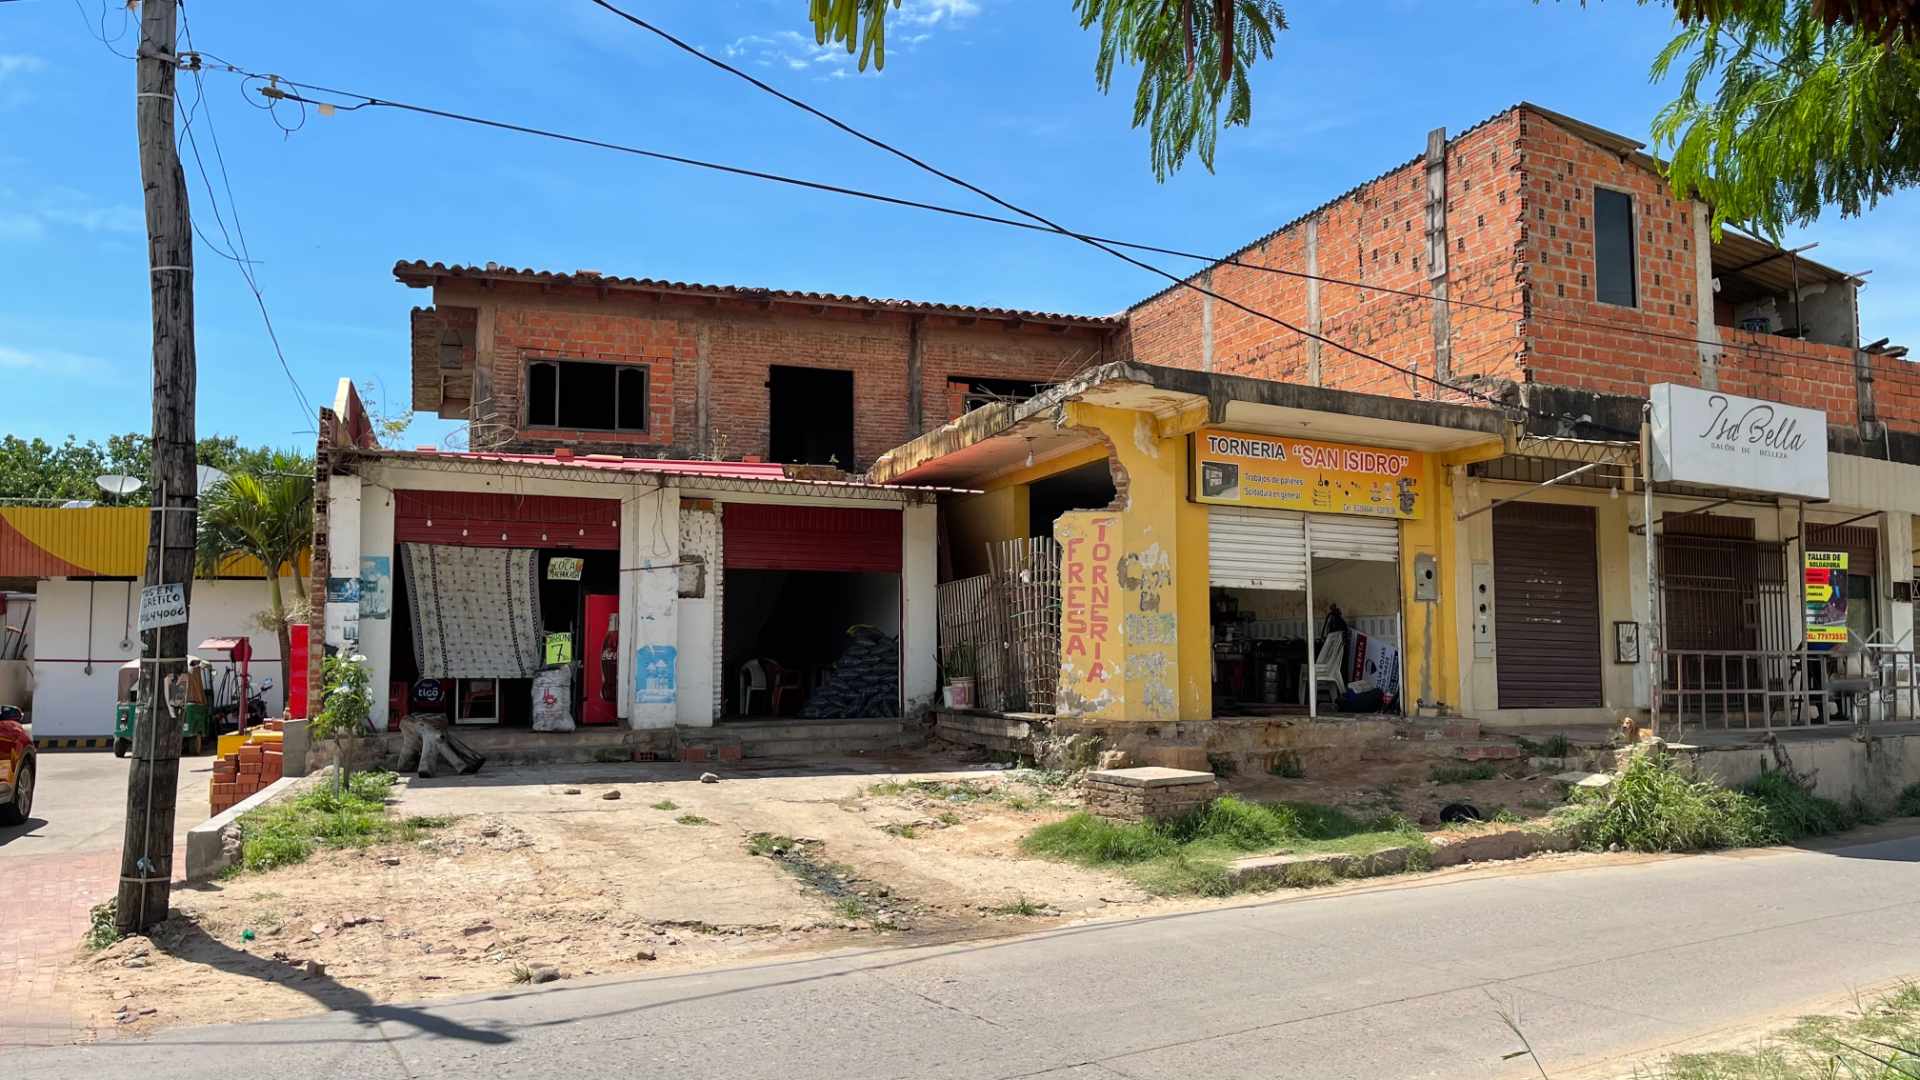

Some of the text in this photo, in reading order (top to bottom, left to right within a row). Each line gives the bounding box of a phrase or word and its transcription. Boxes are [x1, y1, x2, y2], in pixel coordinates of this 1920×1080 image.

[1207, 436, 1285, 460] TORNERIA
[1699, 395, 1808, 451] Isa Bella
[1808, 553, 1841, 561] TALLER DE
[1066, 538, 1087, 656] FRESA
[1087, 518, 1116, 683] TORNERIA
